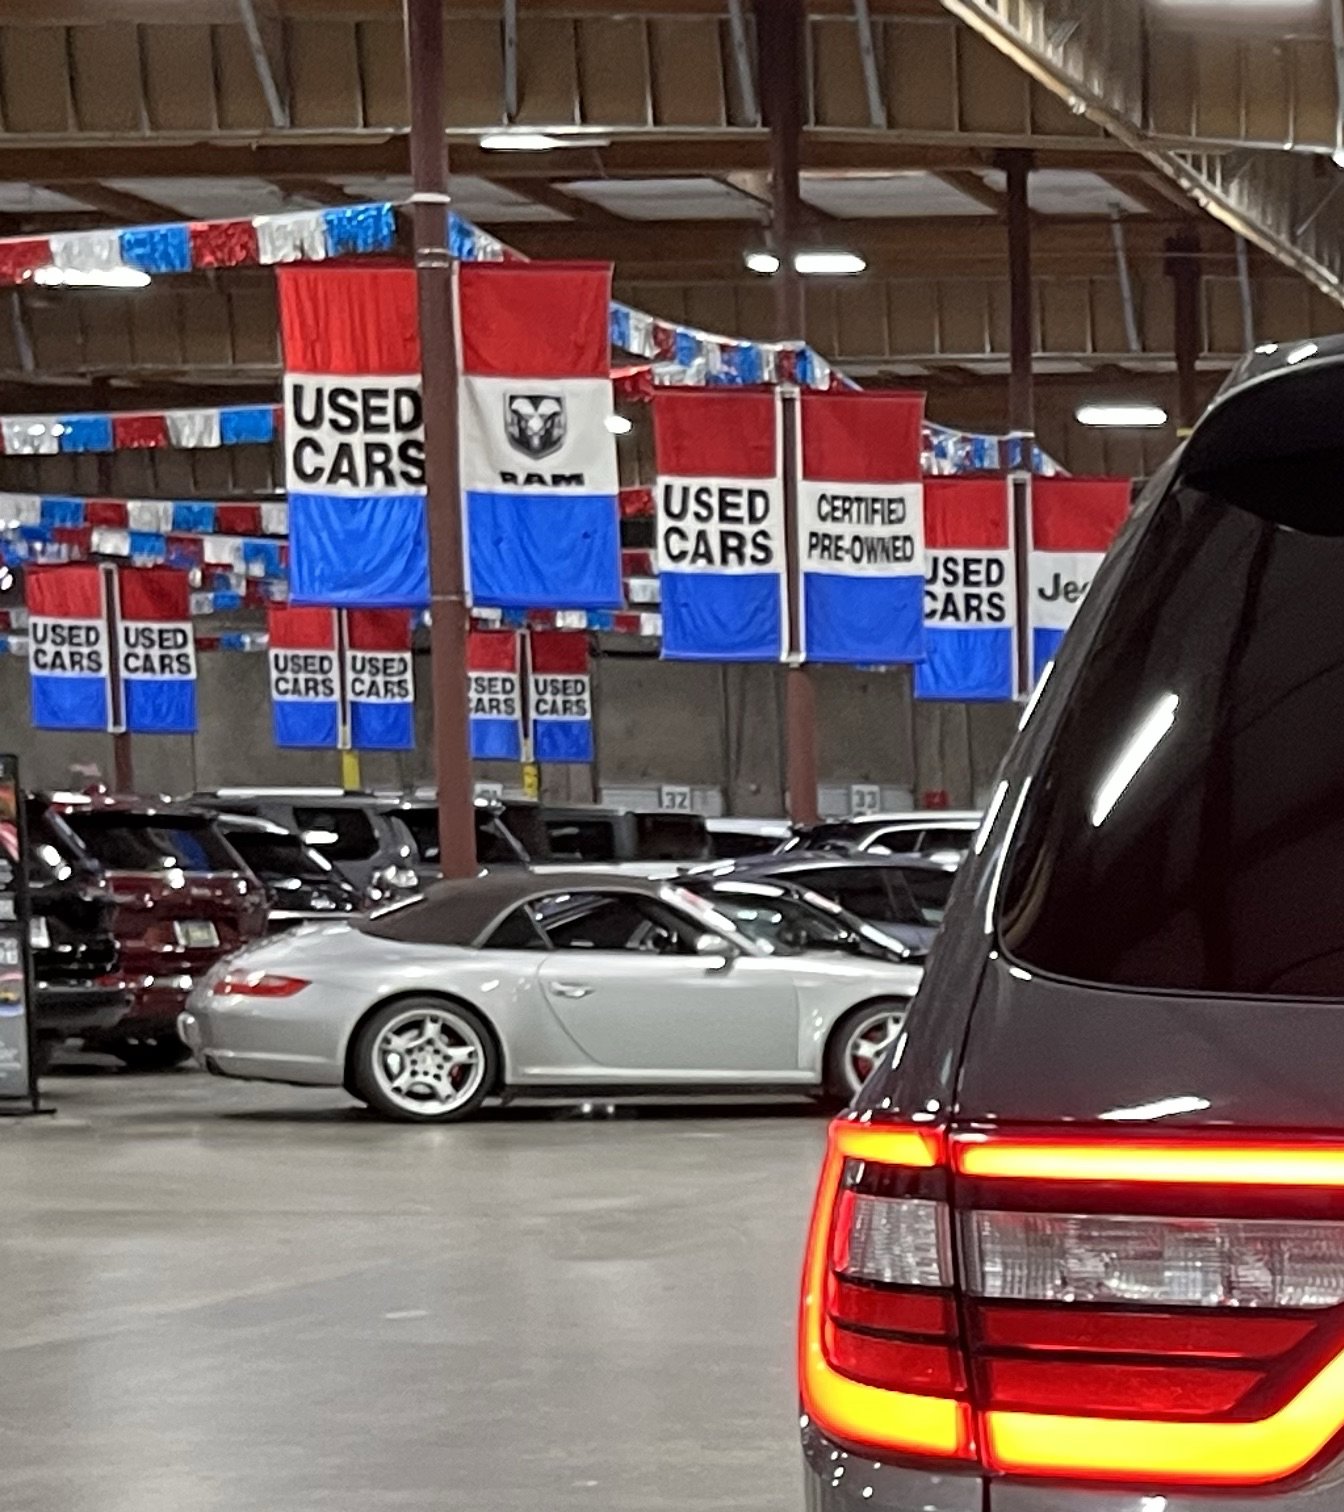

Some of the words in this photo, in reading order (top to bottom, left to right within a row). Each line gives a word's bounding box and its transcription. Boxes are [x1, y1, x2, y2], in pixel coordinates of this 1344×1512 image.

[292, 384, 423, 433] USED
[292, 437, 426, 488] CARS
[500, 471, 586, 487] RAM
[663, 484, 770, 525] USED
[817, 493, 907, 526] CERTIFIED
[663, 526, 774, 567] CARS
[808, 531, 915, 565] PRE-OWNED
[1038, 572, 1090, 604] Je
[32, 622, 101, 647] USED
[124, 626, 189, 650] USED
[33, 649, 103, 672] CARS
[124, 652, 192, 675] CARS
[274, 653, 334, 675] USED
[351, 655, 409, 677] USED
[274, 676, 335, 697] CARS
[351, 677, 410, 699] CARS
[470, 676, 516, 695] SED
[534, 678, 586, 697] USED
[470, 697, 516, 716] ARS
[535, 698, 587, 717] CARS
[665, 789, 690, 809] 32
